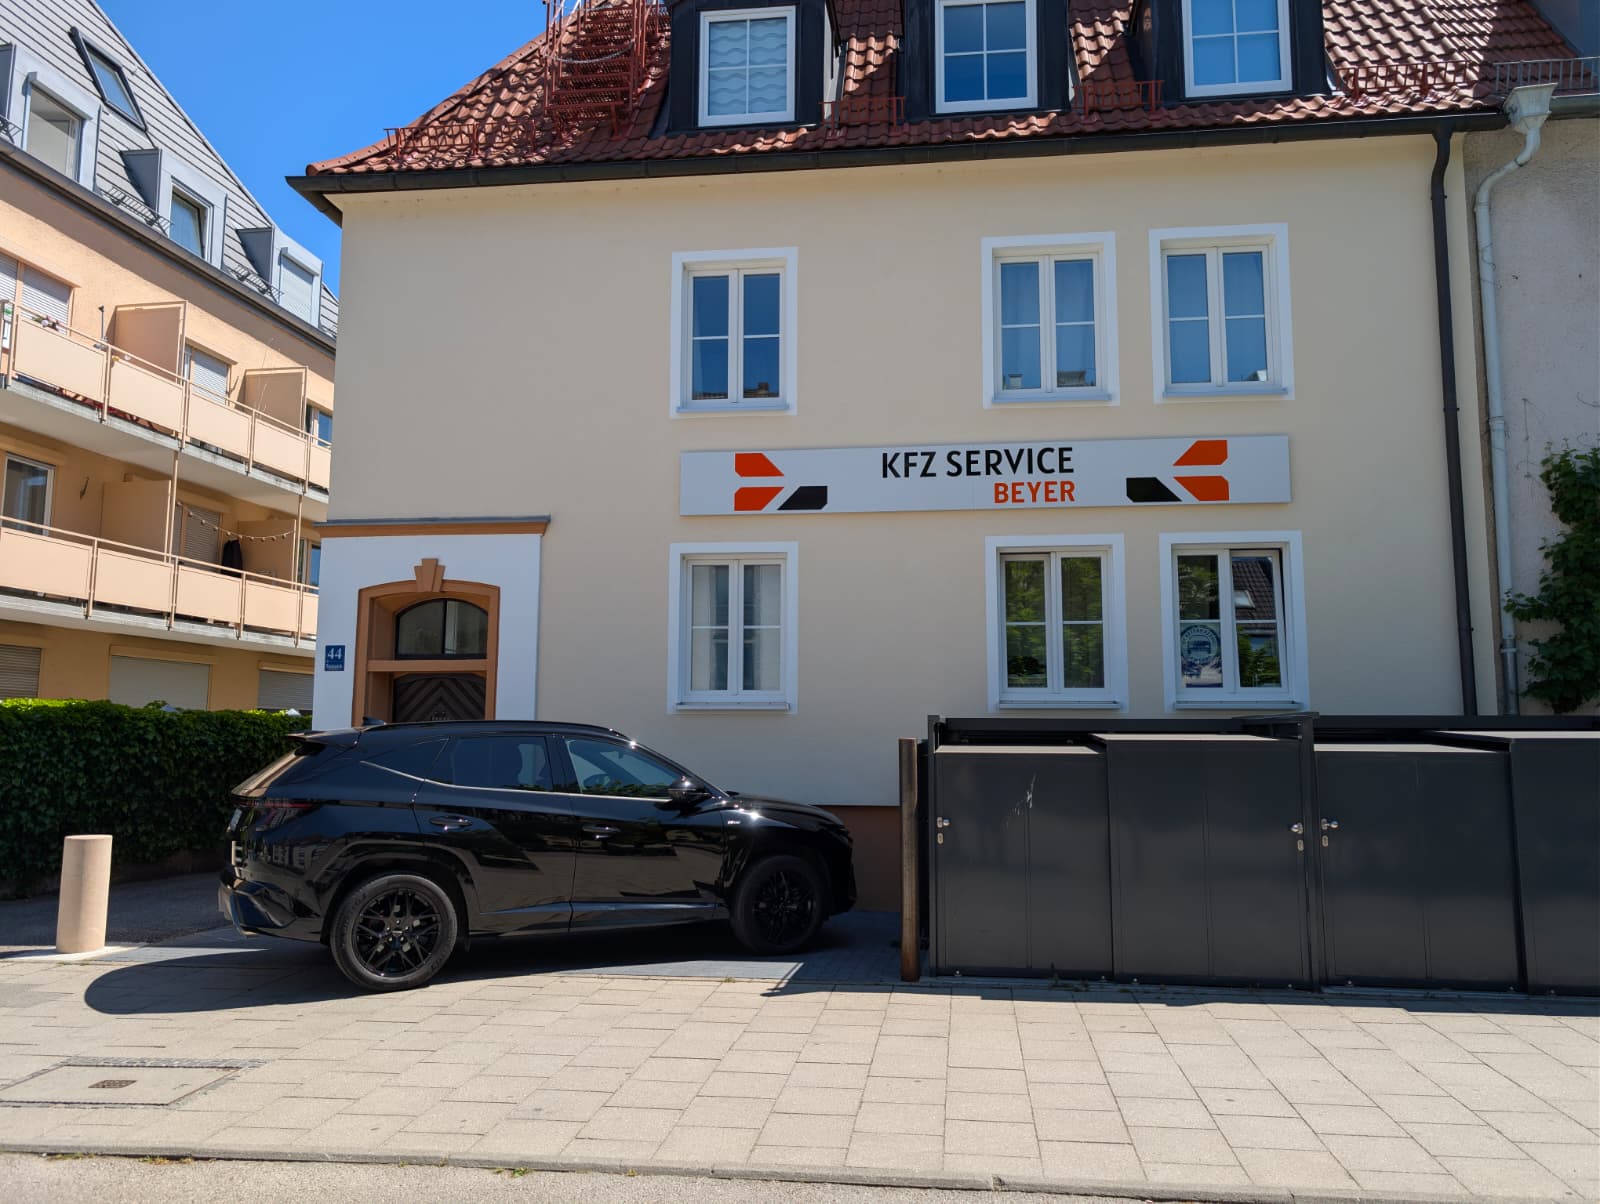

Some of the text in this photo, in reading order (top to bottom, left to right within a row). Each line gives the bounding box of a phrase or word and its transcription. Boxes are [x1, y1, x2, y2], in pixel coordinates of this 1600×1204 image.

[882, 447, 1075, 478] KFZ SERVICE
[994, 480, 1076, 503] BEYER
[327, 647, 342, 660] 44
